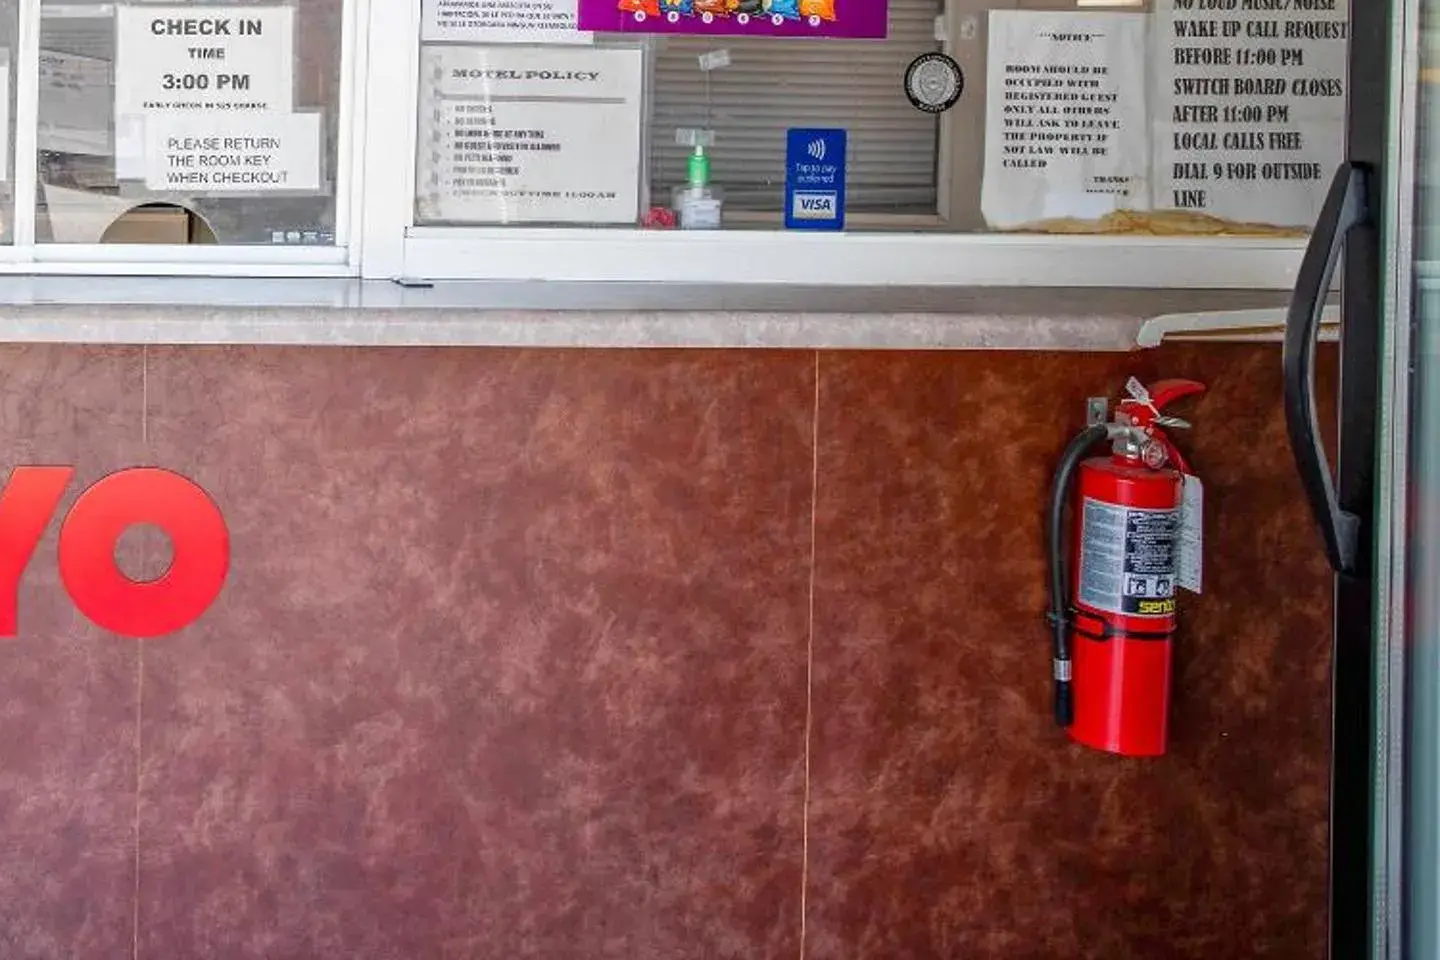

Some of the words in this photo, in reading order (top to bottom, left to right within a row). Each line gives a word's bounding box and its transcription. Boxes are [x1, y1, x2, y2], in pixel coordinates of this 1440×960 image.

[151, 19, 231, 35] CHECK
[239, 20, 261, 35] IN
[1174, 21, 1217, 37] WAKE
[1222, 21, 1241, 37] UP
[1246, 21, 1279, 37] CALL
[1285, 21, 1350, 39] REQUEST
[188, 48, 224, 59] TIME
[1175, 48, 1231, 65] BEFORE
[1237, 48, 1276, 65] 11:00
[1281, 49, 1303, 65] PM
[452, 69, 522, 80] MOTEL
[526, 69, 599, 80] POLICY
[163, 74, 208, 89] 3:00
[217, 74, 249, 90] PM
[1175, 78, 1229, 95] SWITCH
[1234, 79, 1286, 95] BOARD
[1292, 79, 1342, 96] CLOSES
[1005, 92, 1078, 100] REGISTERED
[1081, 94, 1117, 102] GUEST
[1004, 105, 1034, 113] ONLY
[1040, 106, 1056, 114] ALL
[1173, 105, 1218, 122] AFTER
[1224, 105, 1262, 122] 11:00
[1267, 106, 1288, 122] PM
[1004, 119, 1033, 127] WILL
[1082, 120, 1120, 128] LEAVE
[1004, 132, 1024, 140] THE
[1030, 132, 1091, 141] PROPERTY
[1174, 132, 1217, 150] LOCAL
[1223, 132, 1264, 150] CALLS
[1269, 132, 1302, 150] FREE
[168, 138, 219, 150] PLEASE
[224, 138, 280, 150] RETURN
[1004, 146, 1025, 154] NOT
[1029, 146, 1053, 154] LAW
[1059, 147, 1089, 155] WILL
[168, 155, 194, 167] THE
[199, 155, 240, 167] ROOM
[245, 155, 271, 166] KEY
[1003, 159, 1047, 167] CALLED
[796, 162, 808, 173] Tap
[822, 162, 836, 173] pay
[1173, 163, 1208, 179] DIAL
[1213, 163, 1223, 179] 9
[1227, 163, 1256, 179] FOR
[1262, 163, 1321, 180] OUTSIDE
[167, 172, 208, 183] WHEN
[213, 171, 287, 183] CHECKOUT
[1174, 190, 1206, 207] LINE
[802, 200, 830, 210] VISA
